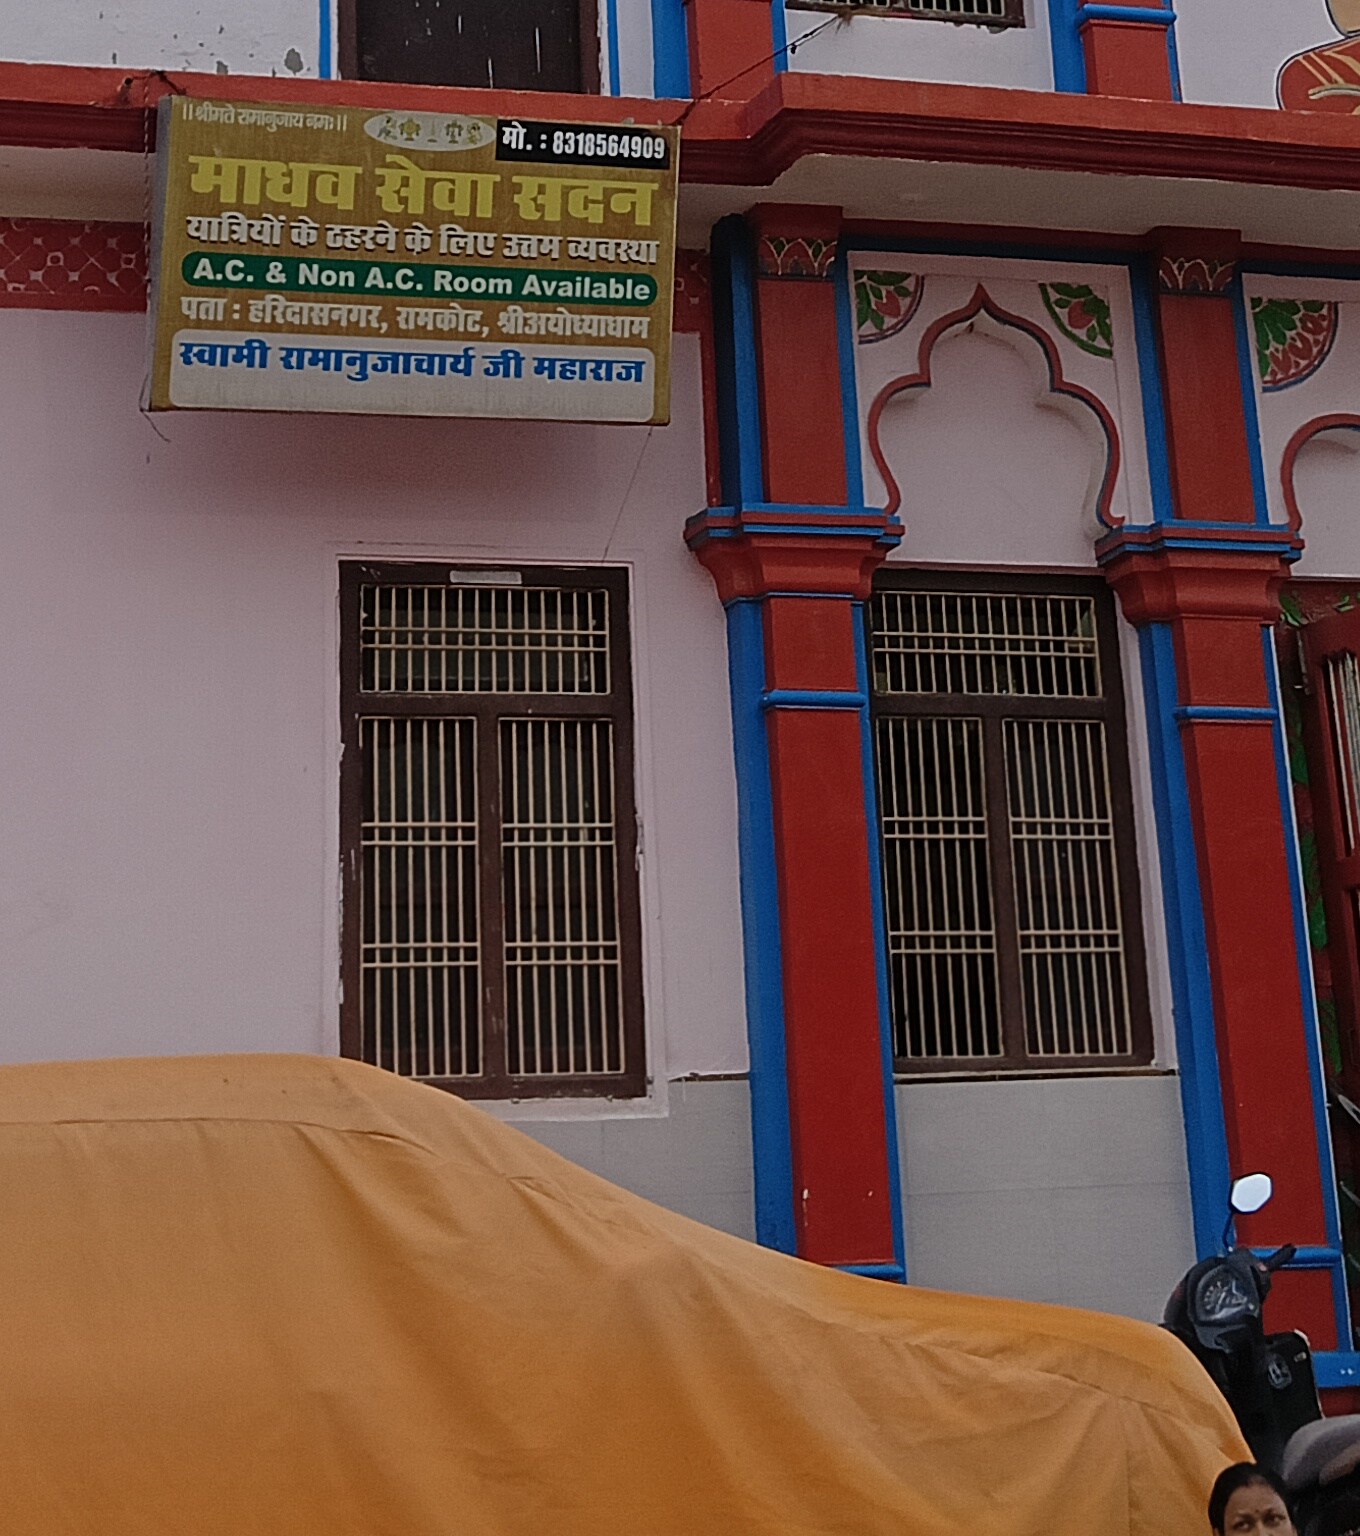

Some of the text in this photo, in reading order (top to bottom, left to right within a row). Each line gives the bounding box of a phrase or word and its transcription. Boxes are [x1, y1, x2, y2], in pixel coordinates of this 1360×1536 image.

[552, 130, 665, 160] 8318564909
[189, 154, 659, 226] माधव सेवा सदन
[186, 211, 660, 264] यात्रियों के ठहरने के लिए उत्तम व्यवस्था
[193, 257, 651, 300] A.C. & Non A.C. Room Available
[180, 296, 228, 321] पता
[179, 338, 646, 383] स्वामी रामानुजाचार्य जी महाराज
